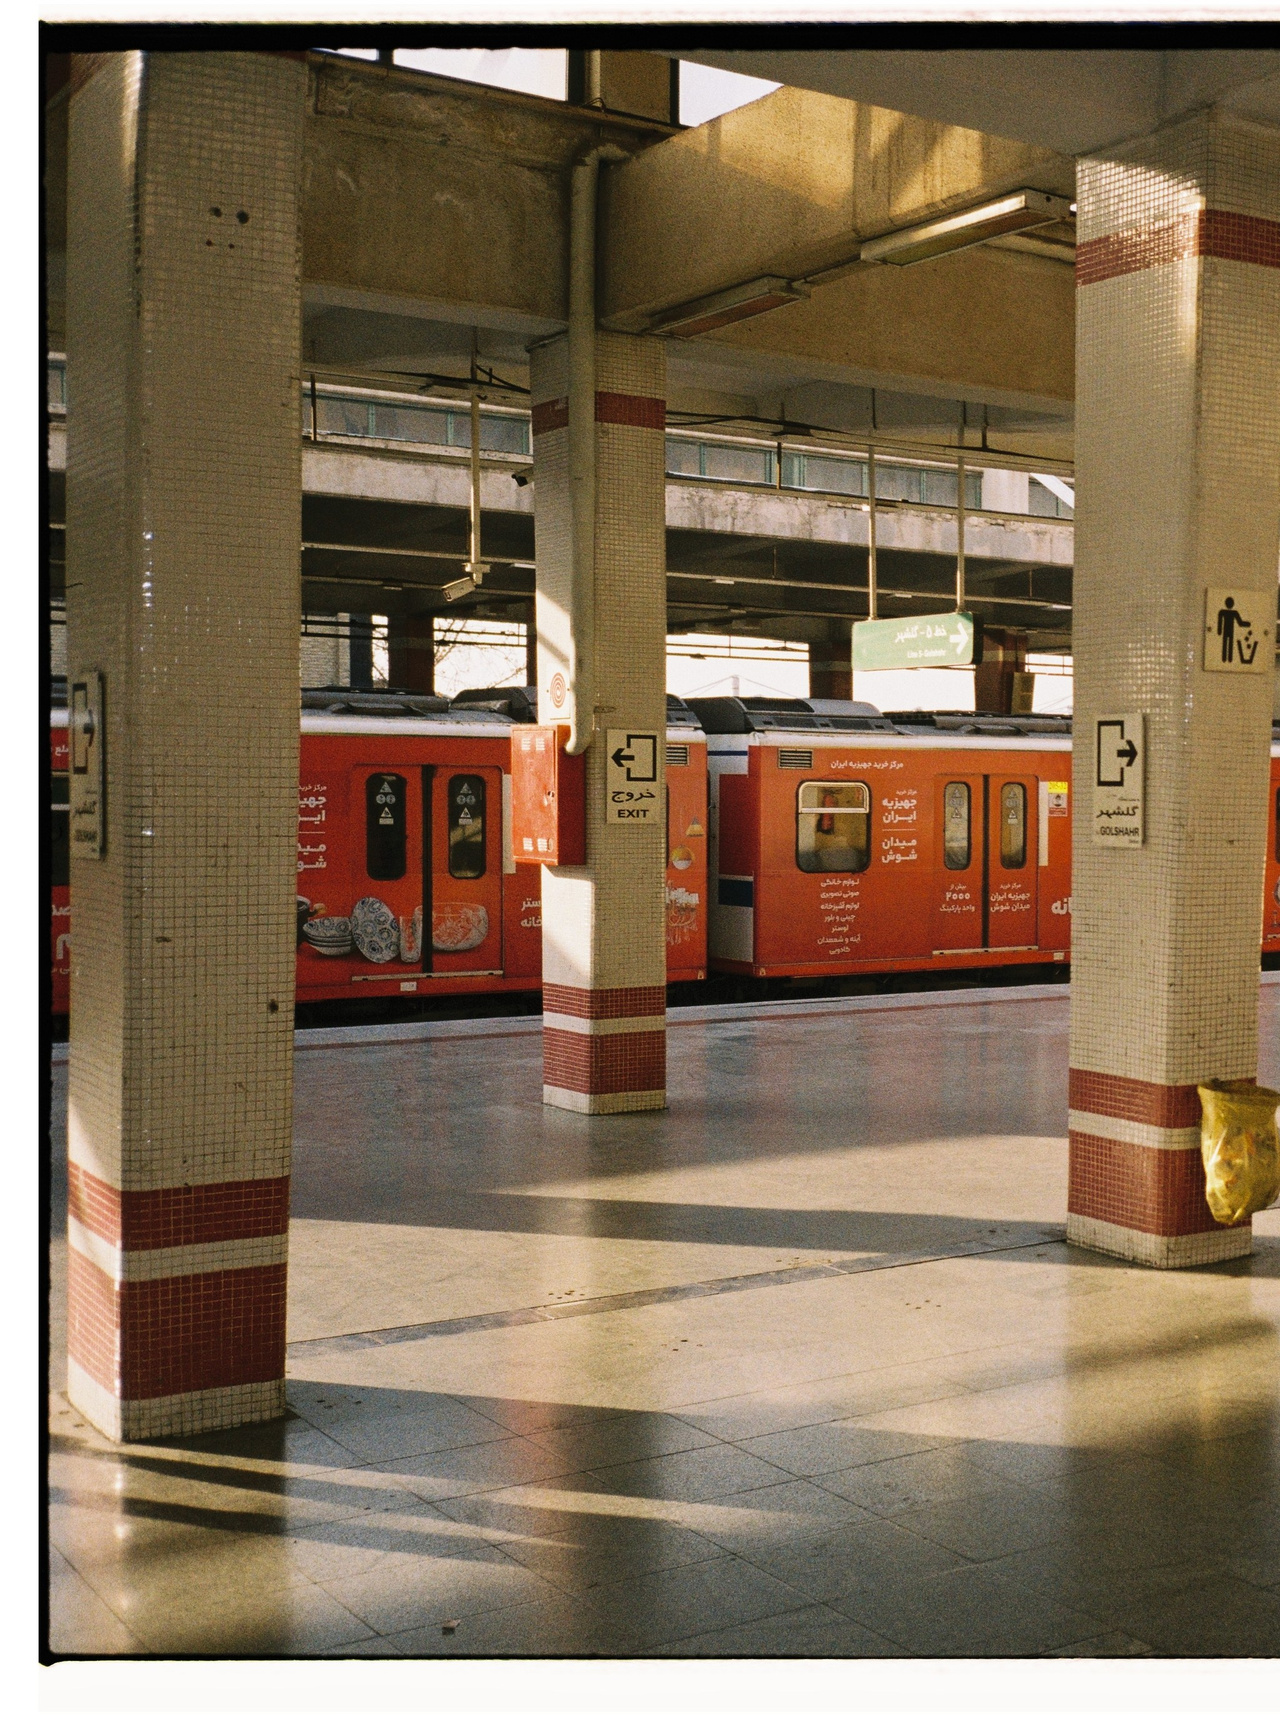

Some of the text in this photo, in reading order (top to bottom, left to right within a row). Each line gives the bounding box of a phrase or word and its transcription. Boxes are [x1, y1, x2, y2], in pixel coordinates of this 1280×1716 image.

[894, 625, 919, 643] گلشهر
[830, 760, 904, 770] مرکز خرید جهیزیه ایران
[313, 784, 327, 792] مرکز
[612, 789, 656, 803] خروج
[882, 797, 917, 810] جهیزیه
[617, 809, 649, 818] EXIT
[882, 811, 917, 823] ایران
[1100, 826, 1139, 836] GOLSHAHR
[882, 837, 917, 849] میدان
[881, 849, 918, 863] شوش
[297, 855, 327, 872] شو
[946, 892, 971, 901] ۲۰۰۰
[990, 892, 1031, 902] جهیزیه ایران
[990, 902, 1031, 912] میدان شوش
